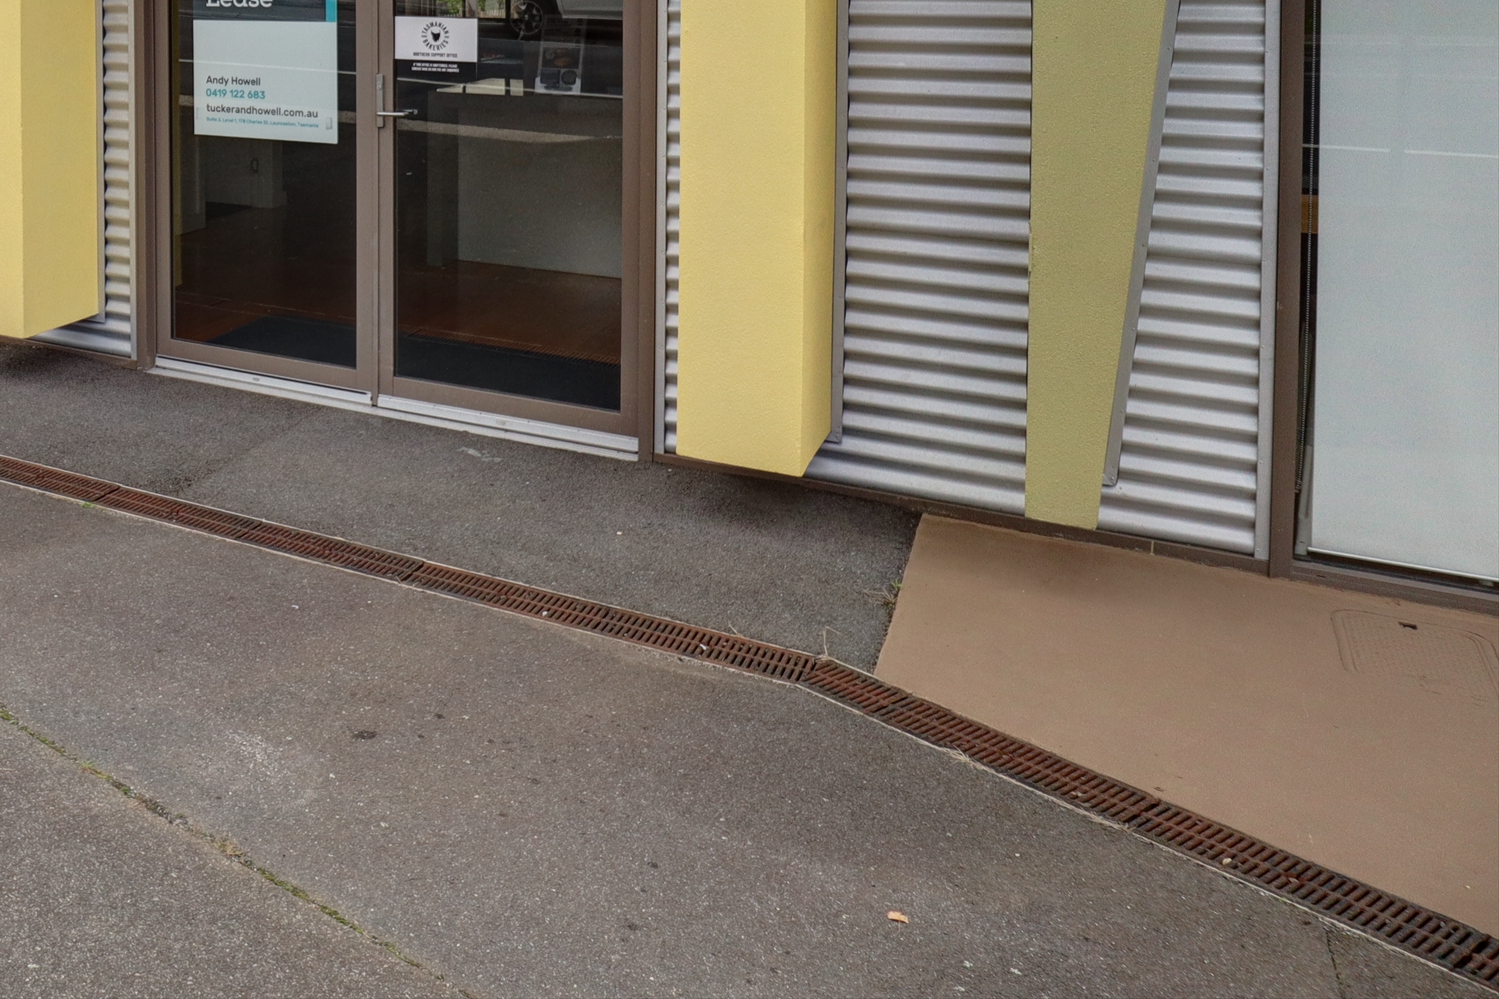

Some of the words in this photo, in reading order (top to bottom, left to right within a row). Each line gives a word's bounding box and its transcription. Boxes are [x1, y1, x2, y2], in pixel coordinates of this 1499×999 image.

[421, 21, 449, 34] TASMANIAN
[206, 75, 229, 86] Andy
[231, 76, 261, 86] Howell
[205, 88, 227, 98] 0419
[229, 89, 245, 98] 122
[247, 90, 266, 99] 683
[206, 103, 319, 118] tuckerandhowell.com.au
